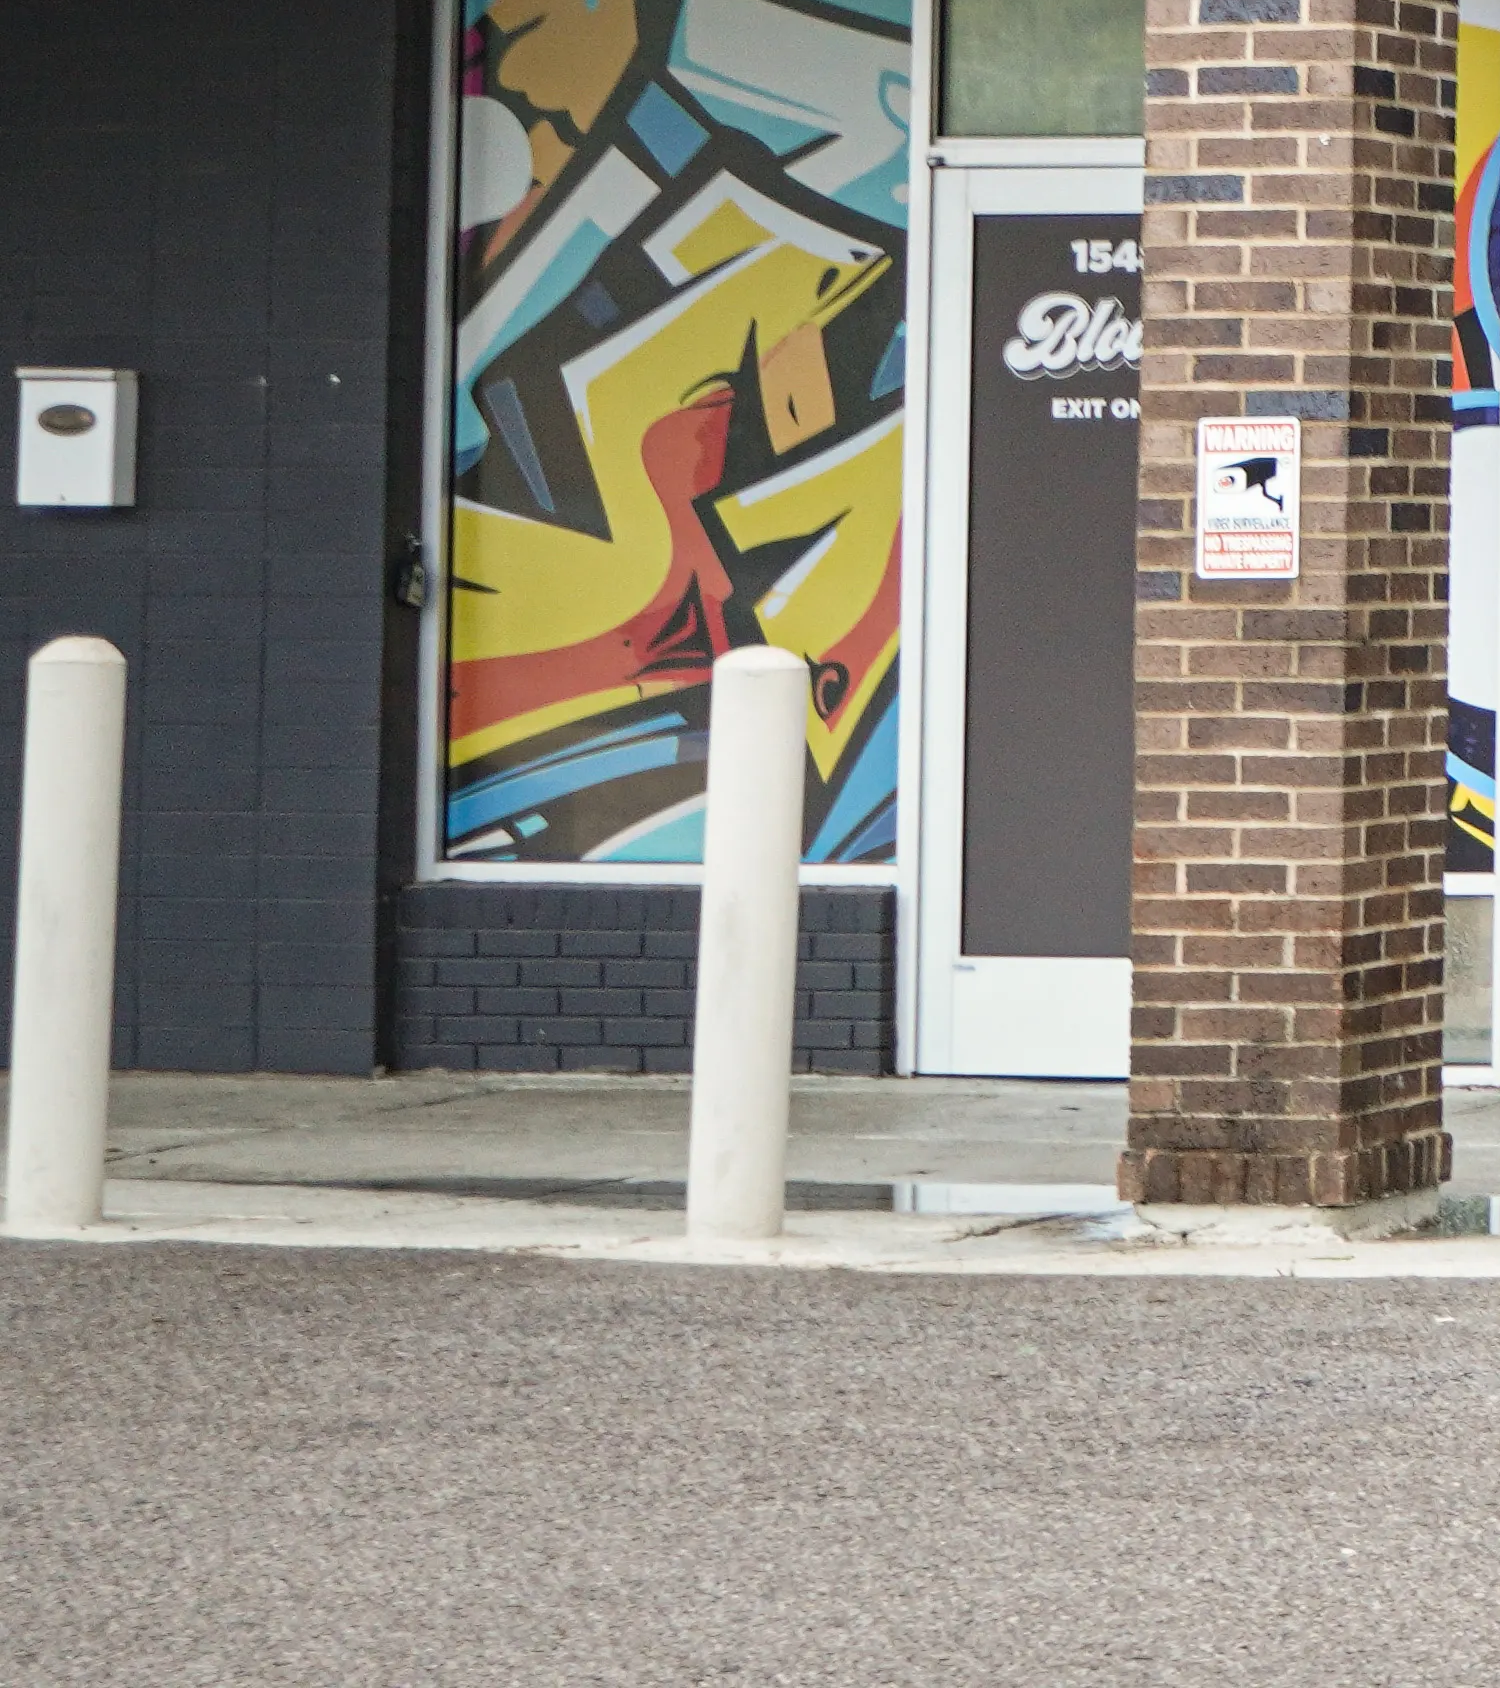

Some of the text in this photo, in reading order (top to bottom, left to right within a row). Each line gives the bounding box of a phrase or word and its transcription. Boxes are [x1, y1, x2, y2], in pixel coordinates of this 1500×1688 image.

[1070, 238, 1144, 273] 154
[1052, 398, 1107, 418] EXIT
[1206, 425, 1294, 452] WARNING
